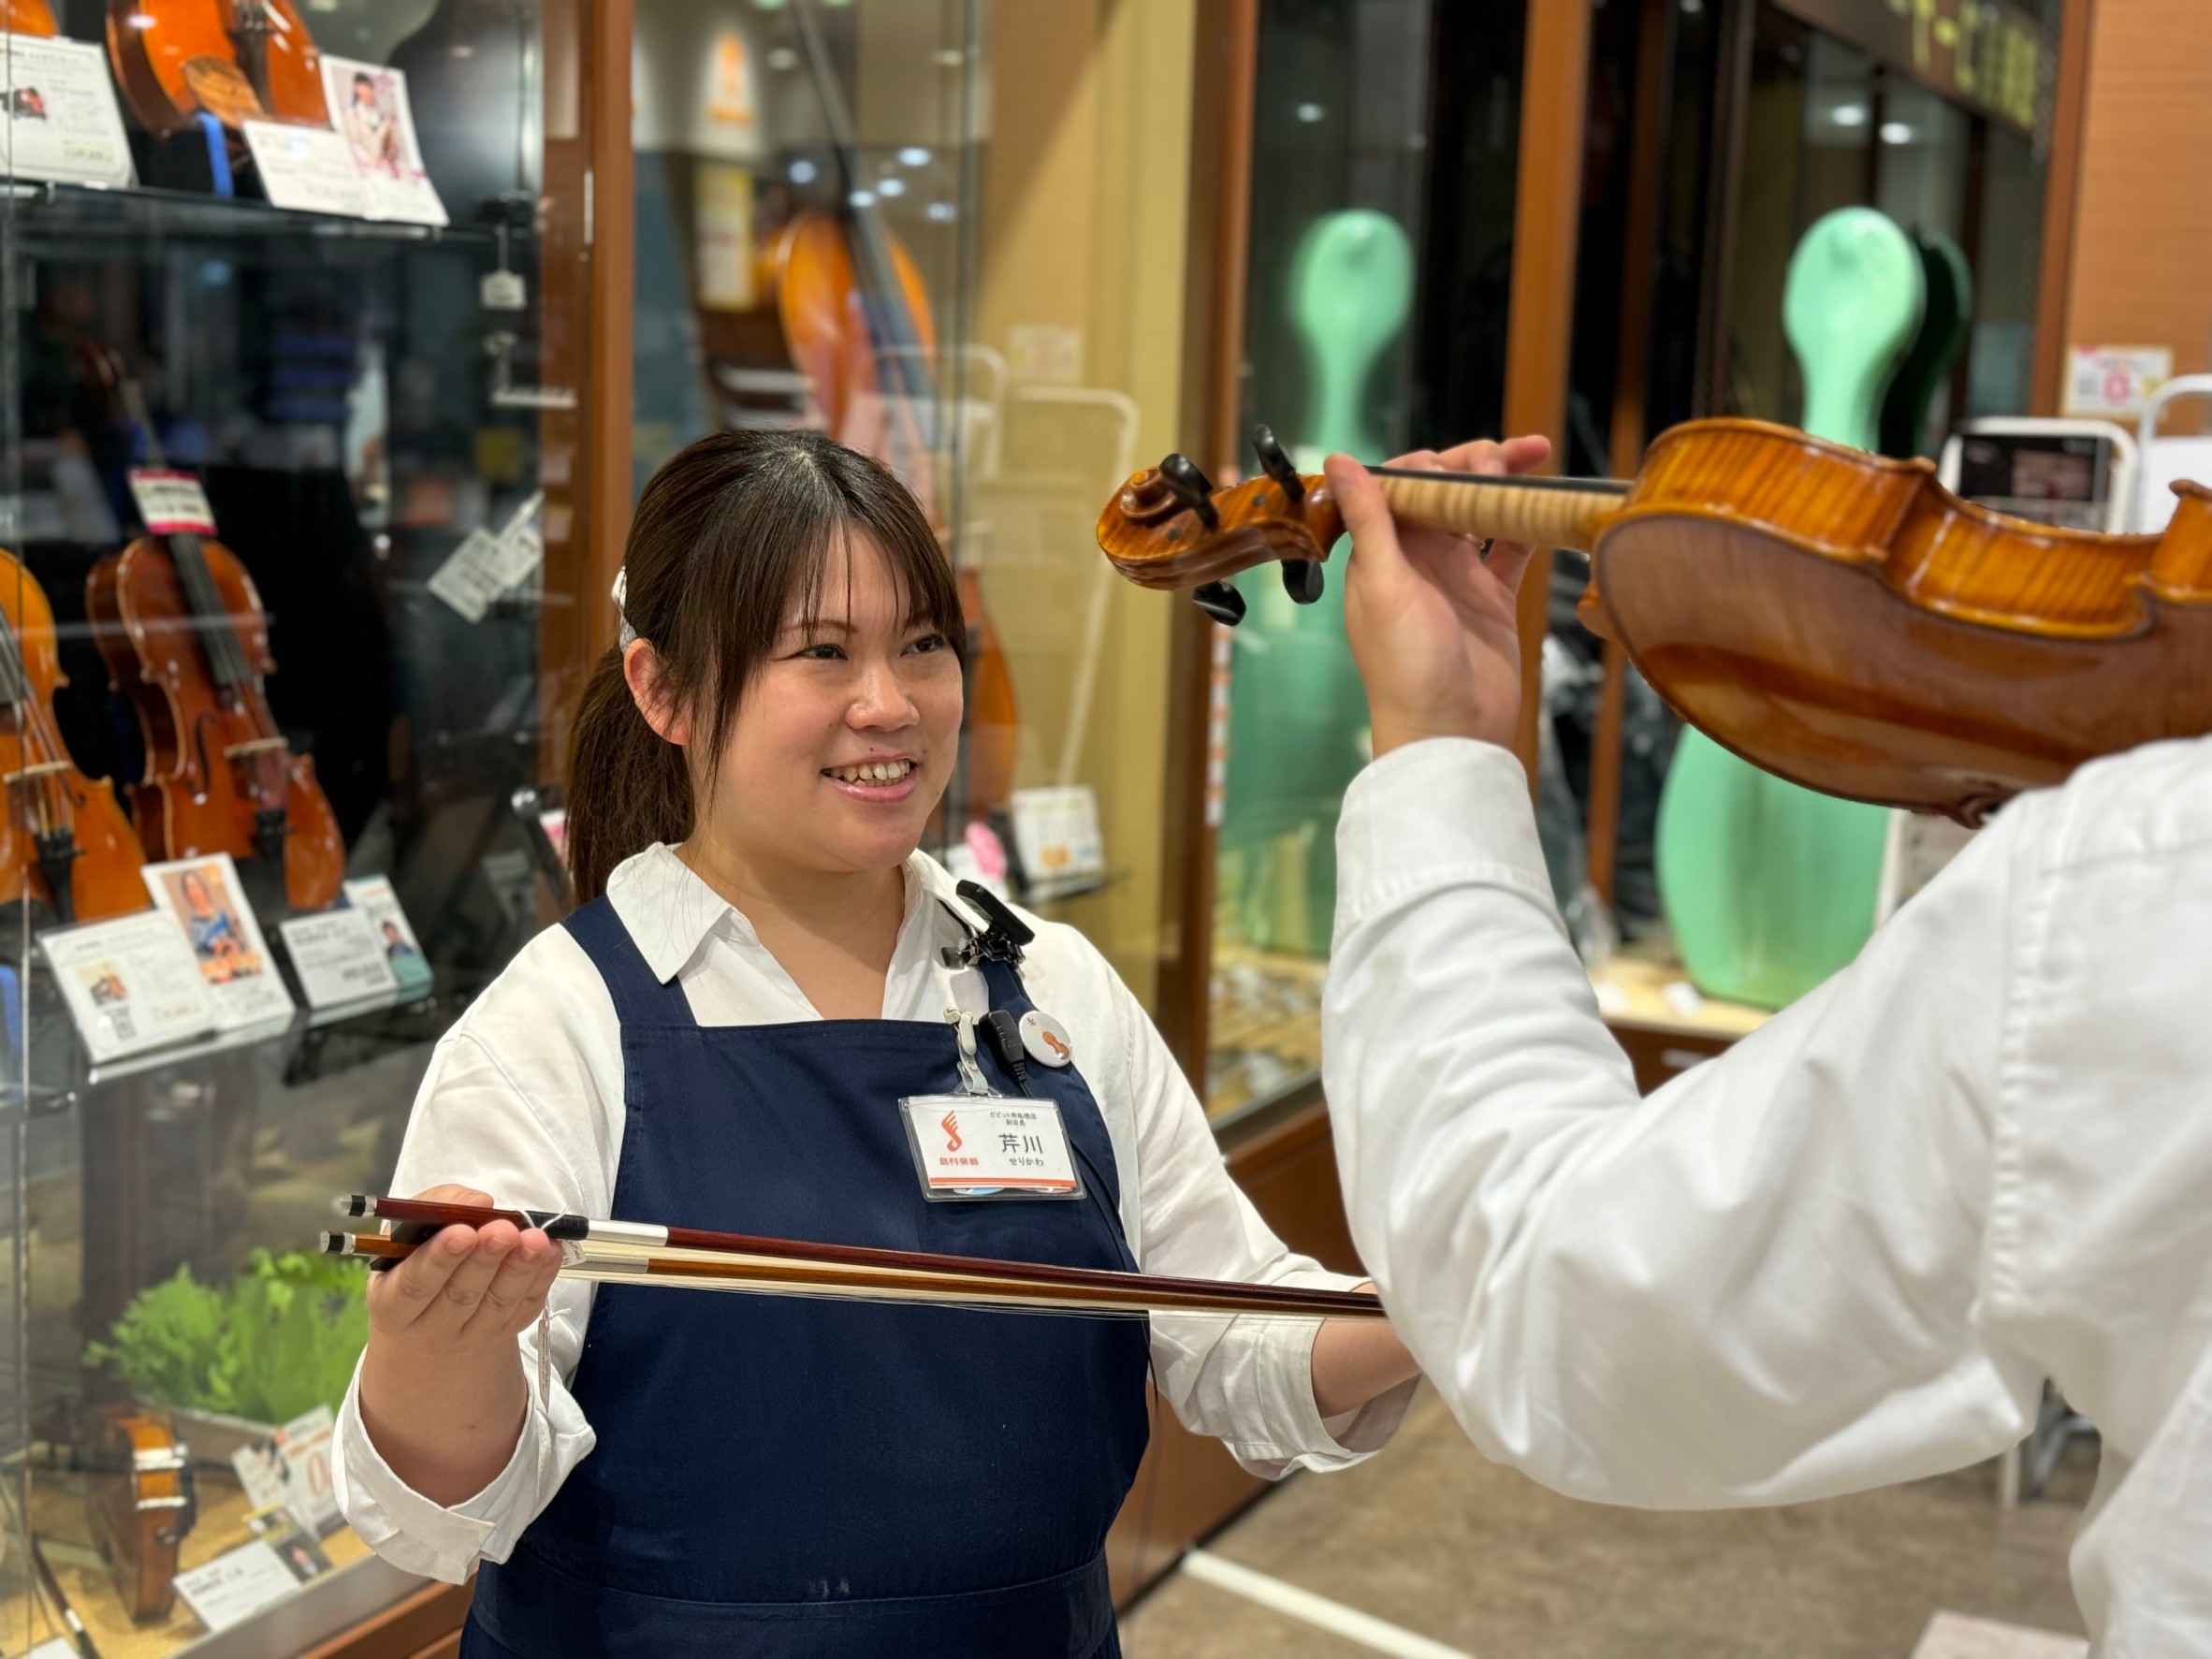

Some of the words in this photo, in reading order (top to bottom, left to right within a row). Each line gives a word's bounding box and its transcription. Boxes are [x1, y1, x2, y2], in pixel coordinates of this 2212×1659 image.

[998, 1133, 1043, 1154] 芹川
[1009, 1157, 1044, 1166] せりかわ
